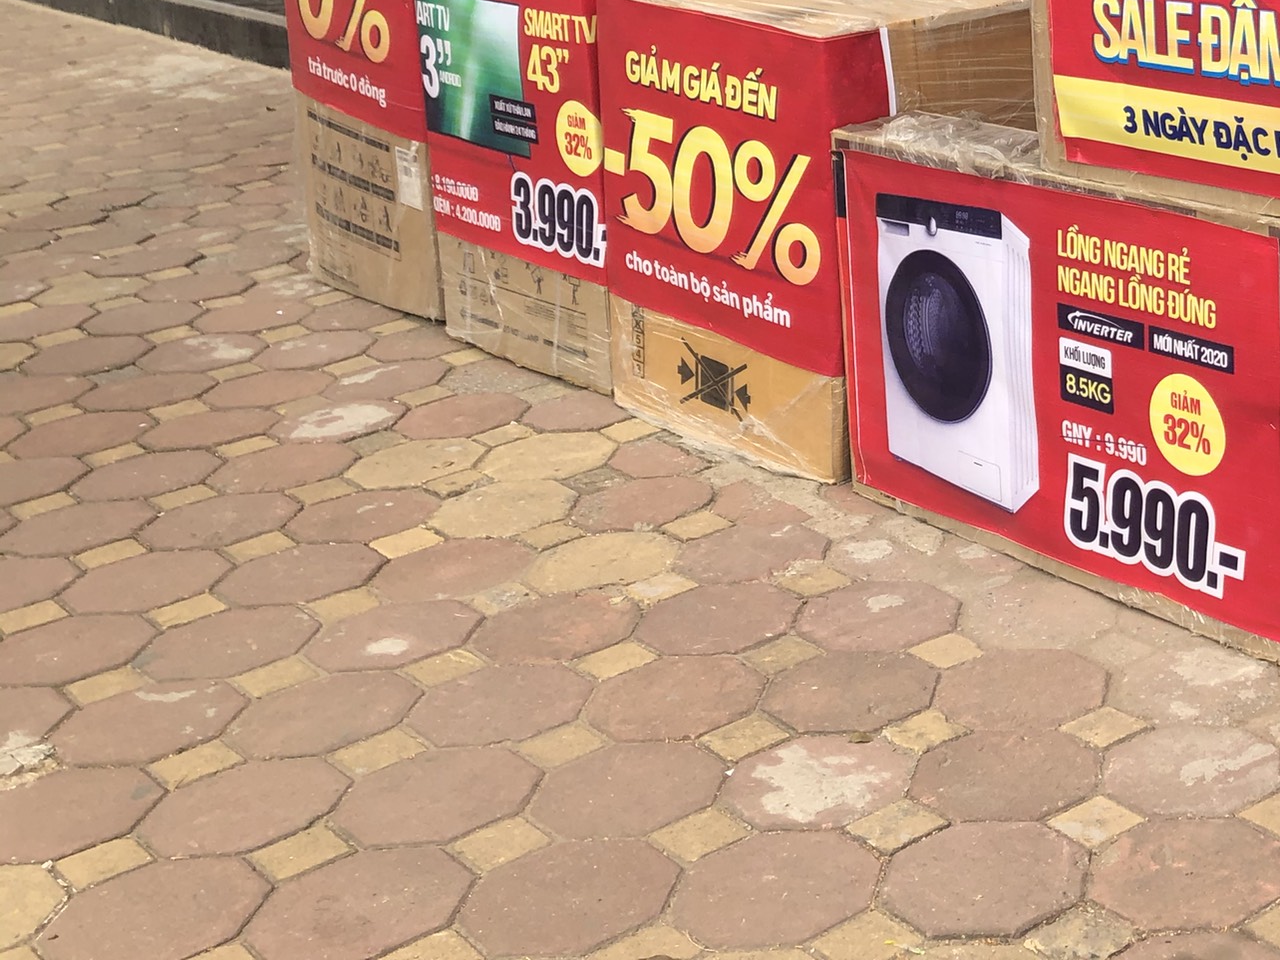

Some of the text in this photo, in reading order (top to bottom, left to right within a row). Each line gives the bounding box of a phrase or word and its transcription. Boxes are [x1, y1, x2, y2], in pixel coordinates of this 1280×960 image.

[435, 5, 450, 31] TV
[524, 7, 598, 44] SMART TV
[308, 55, 387, 108] trả trước 0 đồng
[625, 45, 777, 120] GIẢM GIÁ ĐẾN
[567, 113, 586, 131] GIẢM
[1122, 105, 1138, 134] 3
[1142, 105, 1208, 146] NGÀY
[1213, 116, 1272, 161] ĐẶC
[564, 131, 593, 160] 32%
[1057, 223, 1192, 285] LỒNG NGANG RẺ
[625, 250, 791, 329] cho toàn bộ sản phẩm
[1057, 264, 1217, 330] NGANG LỒNG ĐỨNG
[1067, 311, 1133, 343] INVERTER
[1063, 338, 1107, 373] KHỐI LƯỢNG
[1153, 332, 1228, 369] MỚI NHẤT 2020
[1066, 373, 1111, 404] 8.5KG
[1170, 389, 1201, 416] GIẢM
[1061, 420, 1147, 466] GNY 9.990
[1163, 413, 1212, 456] 32%
